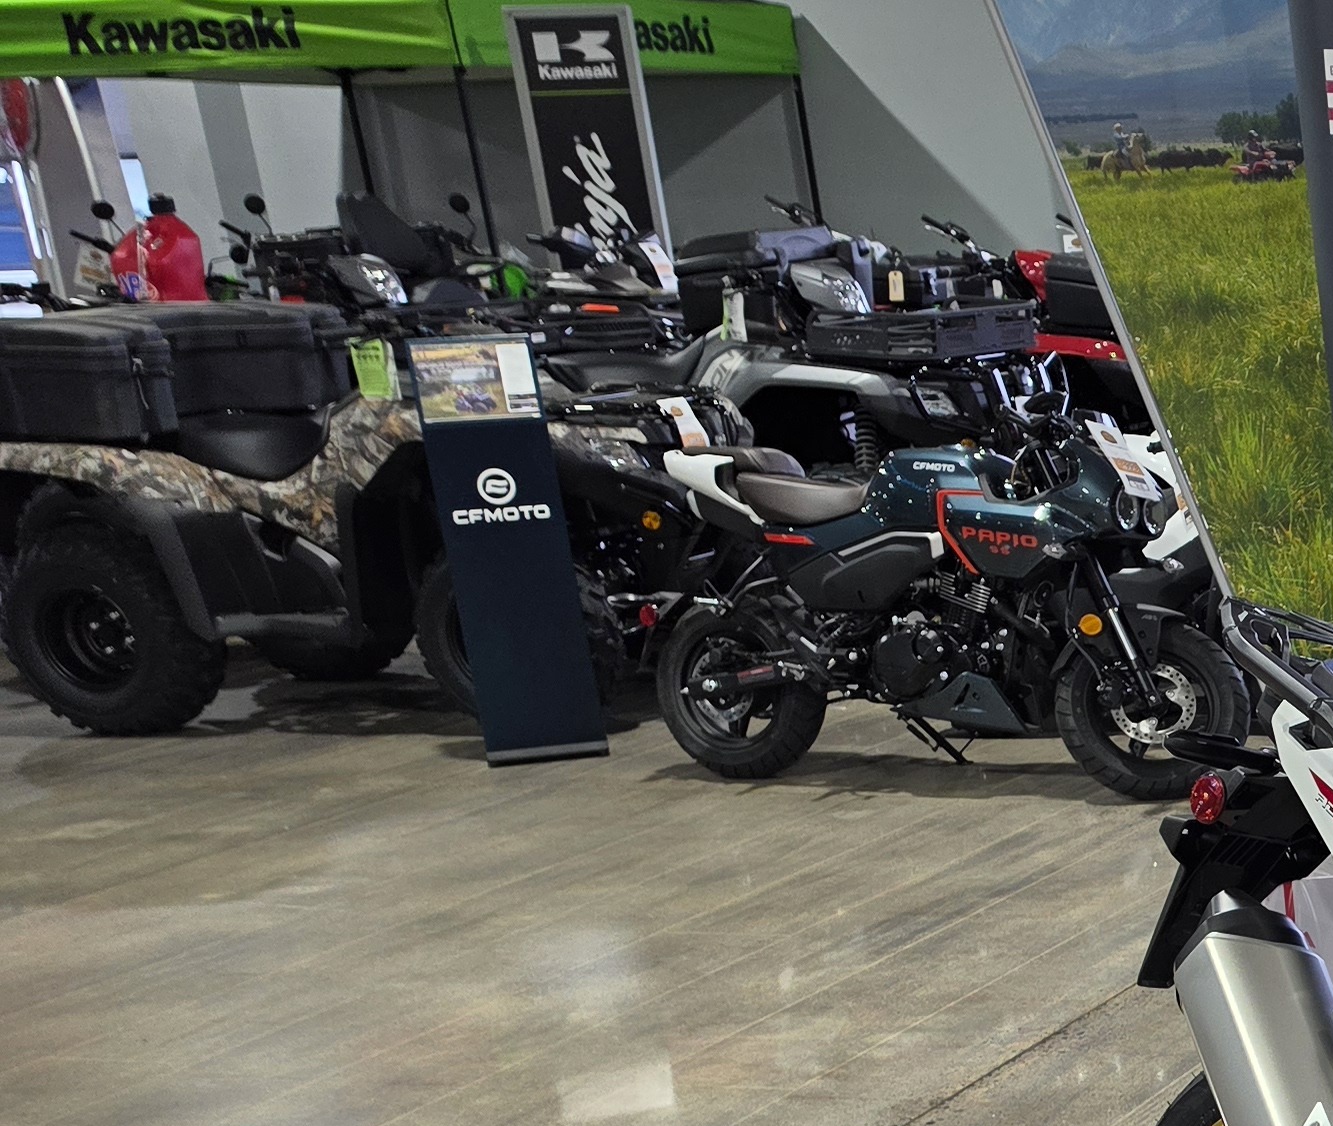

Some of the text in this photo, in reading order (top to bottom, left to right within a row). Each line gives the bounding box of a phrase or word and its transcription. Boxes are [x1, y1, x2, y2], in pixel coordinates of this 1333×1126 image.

[60, 5, 300, 56] Kawasaki
[633, 14, 716, 54] asaki
[537, 62, 618, 81] Kawasaki
[912, 460, 956, 473] CFMOTO
[452, 503, 551, 526] CFMOTO
[961, 526, 1039, 549] PAPIO
